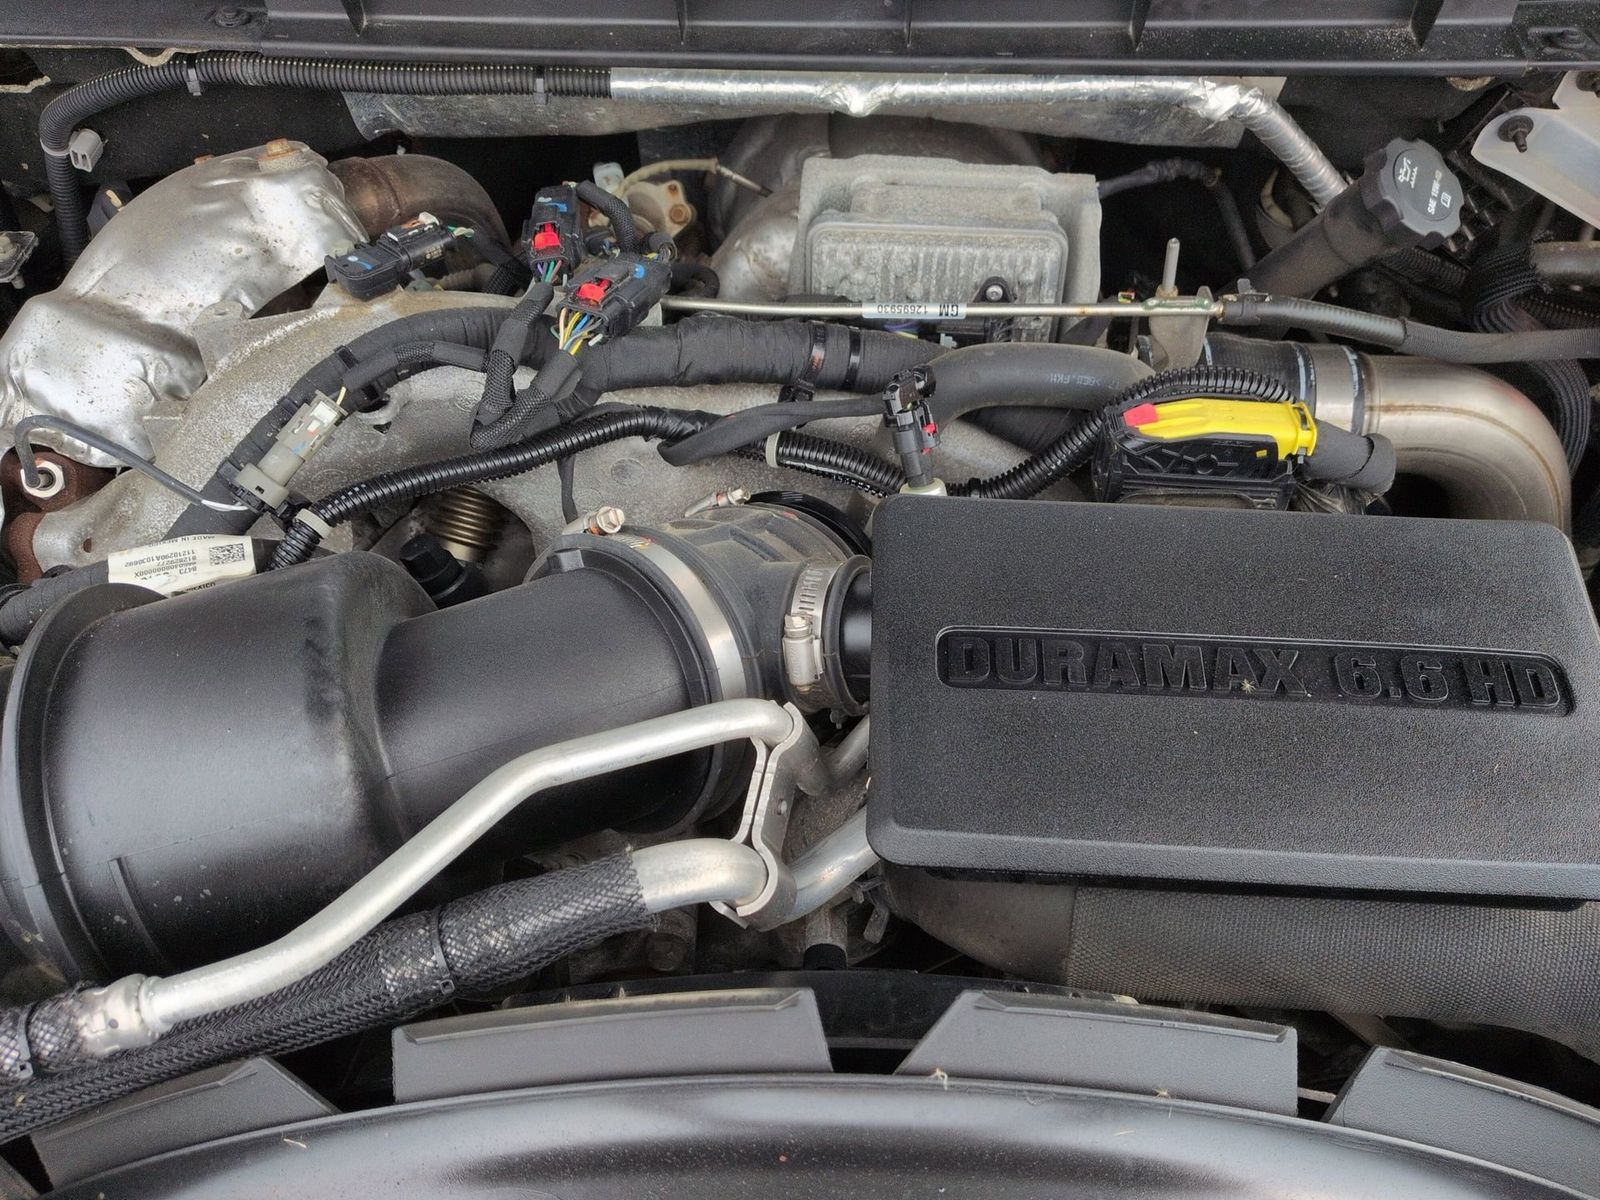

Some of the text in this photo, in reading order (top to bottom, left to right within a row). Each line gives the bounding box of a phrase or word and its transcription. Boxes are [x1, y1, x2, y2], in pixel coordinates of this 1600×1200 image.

[1427, 197, 1437, 215] SAE
[877, 304, 959, 317] GM 12695930
[947, 635, 1561, 708] DURAMAX 6.6 HD
